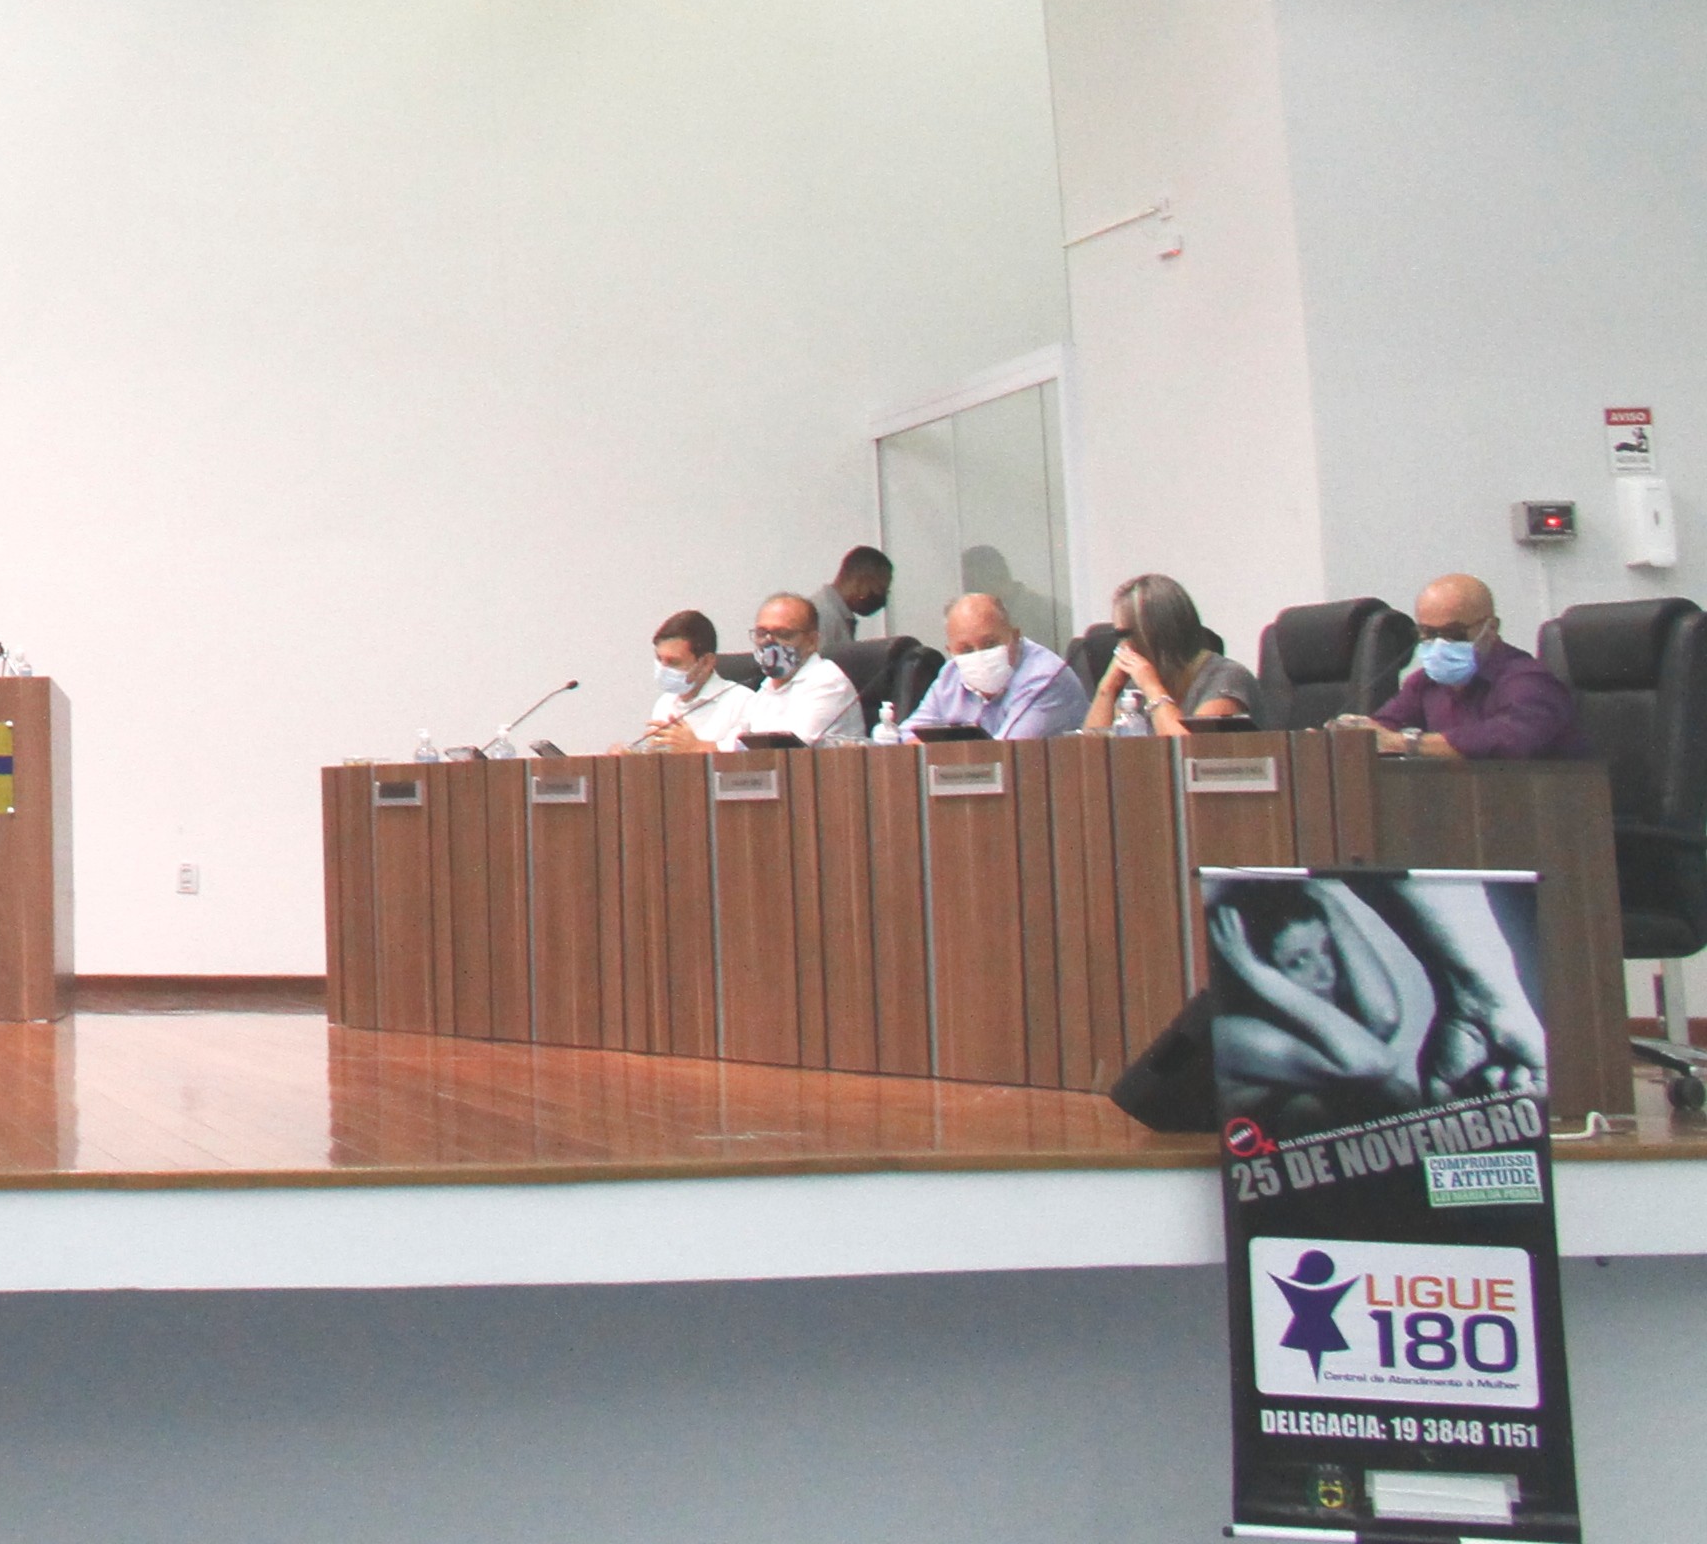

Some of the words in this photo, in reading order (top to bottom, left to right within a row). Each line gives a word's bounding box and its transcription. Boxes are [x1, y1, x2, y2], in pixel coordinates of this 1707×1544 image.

[1610, 411, 1647, 422] AVISO
[1231, 1157, 1281, 1202] 25
[1284, 1145, 1336, 1190] DE
[1336, 1098, 1543, 1178] NOVEMBRO
[1429, 1154, 1533, 1171] COMPROMISSO
[1433, 1173, 1444, 1189] E
[1452, 1168, 1536, 1188] ATITUDE
[1365, 1273, 1516, 1312] LIGUE
[1368, 1309, 1519, 1374] 180
[1324, 1371, 1367, 1382] Central
[1389, 1375, 1463, 1388] Atendimento
[1477, 1379, 1520, 1390] Mulher
[1260, 1408, 1387, 1441] DELEGACIA:
[1390, 1416, 1418, 1442] 19
[1422, 1418, 1485, 1445] 3848
[1489, 1422, 1539, 1448] 1151
